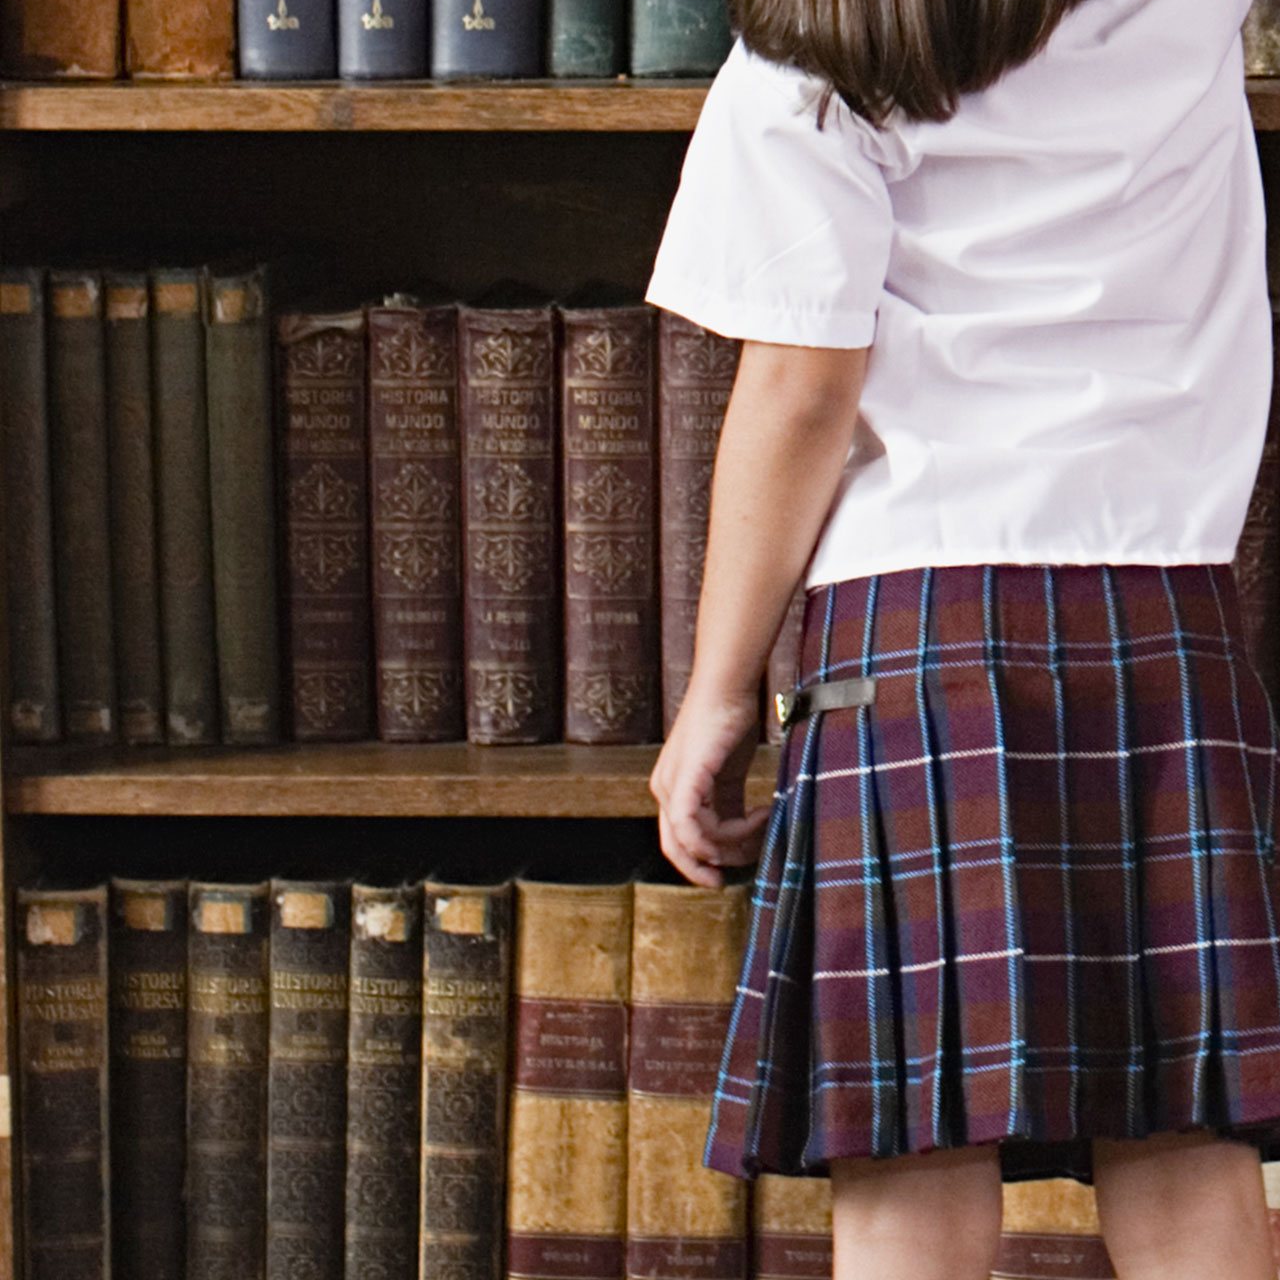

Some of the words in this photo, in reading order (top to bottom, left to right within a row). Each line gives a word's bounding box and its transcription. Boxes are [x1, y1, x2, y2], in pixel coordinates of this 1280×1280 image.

[381, 389, 448, 405] HISTORIA
[476, 389, 545, 405] HISTORIA
[574, 390, 643, 406] HISTORIA
[385, 414, 445, 430] MUNDO
[481, 415, 541, 430] MUNDO
[578, 415, 638, 430] MUNDO
[525, 1058, 617, 1070] UNIVERSAL
